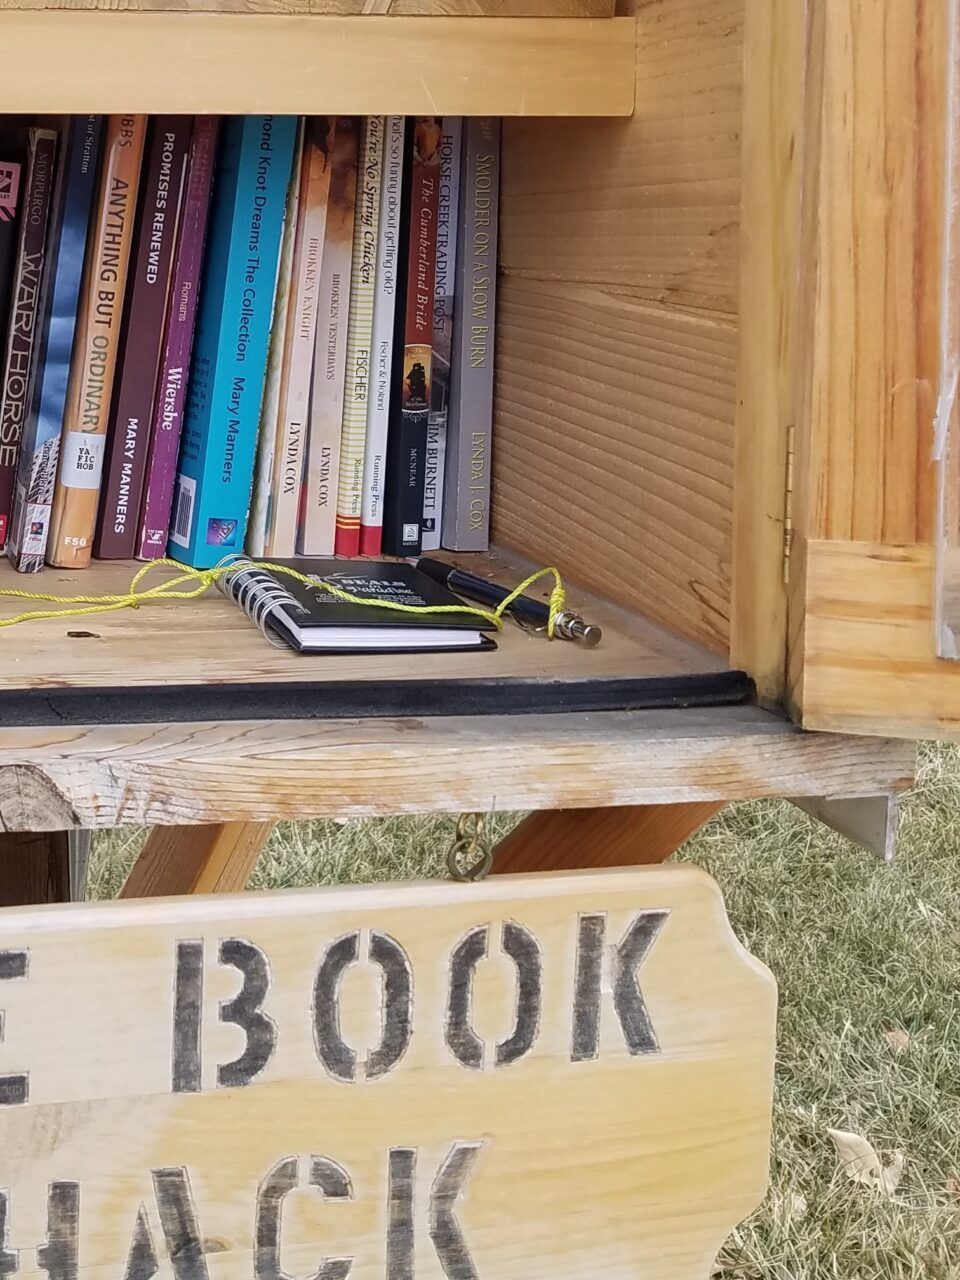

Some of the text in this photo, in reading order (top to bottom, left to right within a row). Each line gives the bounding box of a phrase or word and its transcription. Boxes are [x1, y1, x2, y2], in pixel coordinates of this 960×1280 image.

[30, 152, 49, 225] MORPURGO
[146, 132, 176, 284] PROMISES RENEWED
[359, 115, 383, 286] You're No Spring Chicken
[474, 154, 494, 227] SMOLDER
[94, 177, 130, 328] ANYTHING BUT
[383, 162, 401, 296] funny about getting old?
[415, 178, 434, 331] The Cumberland Bride
[433, 135, 453, 333] HORSE CREEK TRADING POST
[472, 232, 490, 257] ON
[178, 281, 192, 322] Romans
[221, 157, 272, 484] Knot Dreams The Collection Mary Manners
[471, 275, 492, 320] SLOW
[326, 321, 338, 381] YESTERDAYS
[355, 349, 368, 402] FISCHER
[469, 325, 490, 369] BURN
[0, 350, 30, 467] HORSE
[161, 366, 183, 431] Wiersbe
[77, 455, 95, 463] FIC
[114, 417, 139, 534] MARY MANNERS
[283, 421, 302, 495] LYNDA COX
[318, 446, 331, 507] LYNDA COX
[352, 458, 362, 492] Running
[370, 454, 381, 518] Running Press
[424, 447, 438, 510] BURNETT
[469, 431, 487, 531] LYNDA COX
[64, 536, 87, 546] FSG
[172, 907, 672, 1094] BOOK
